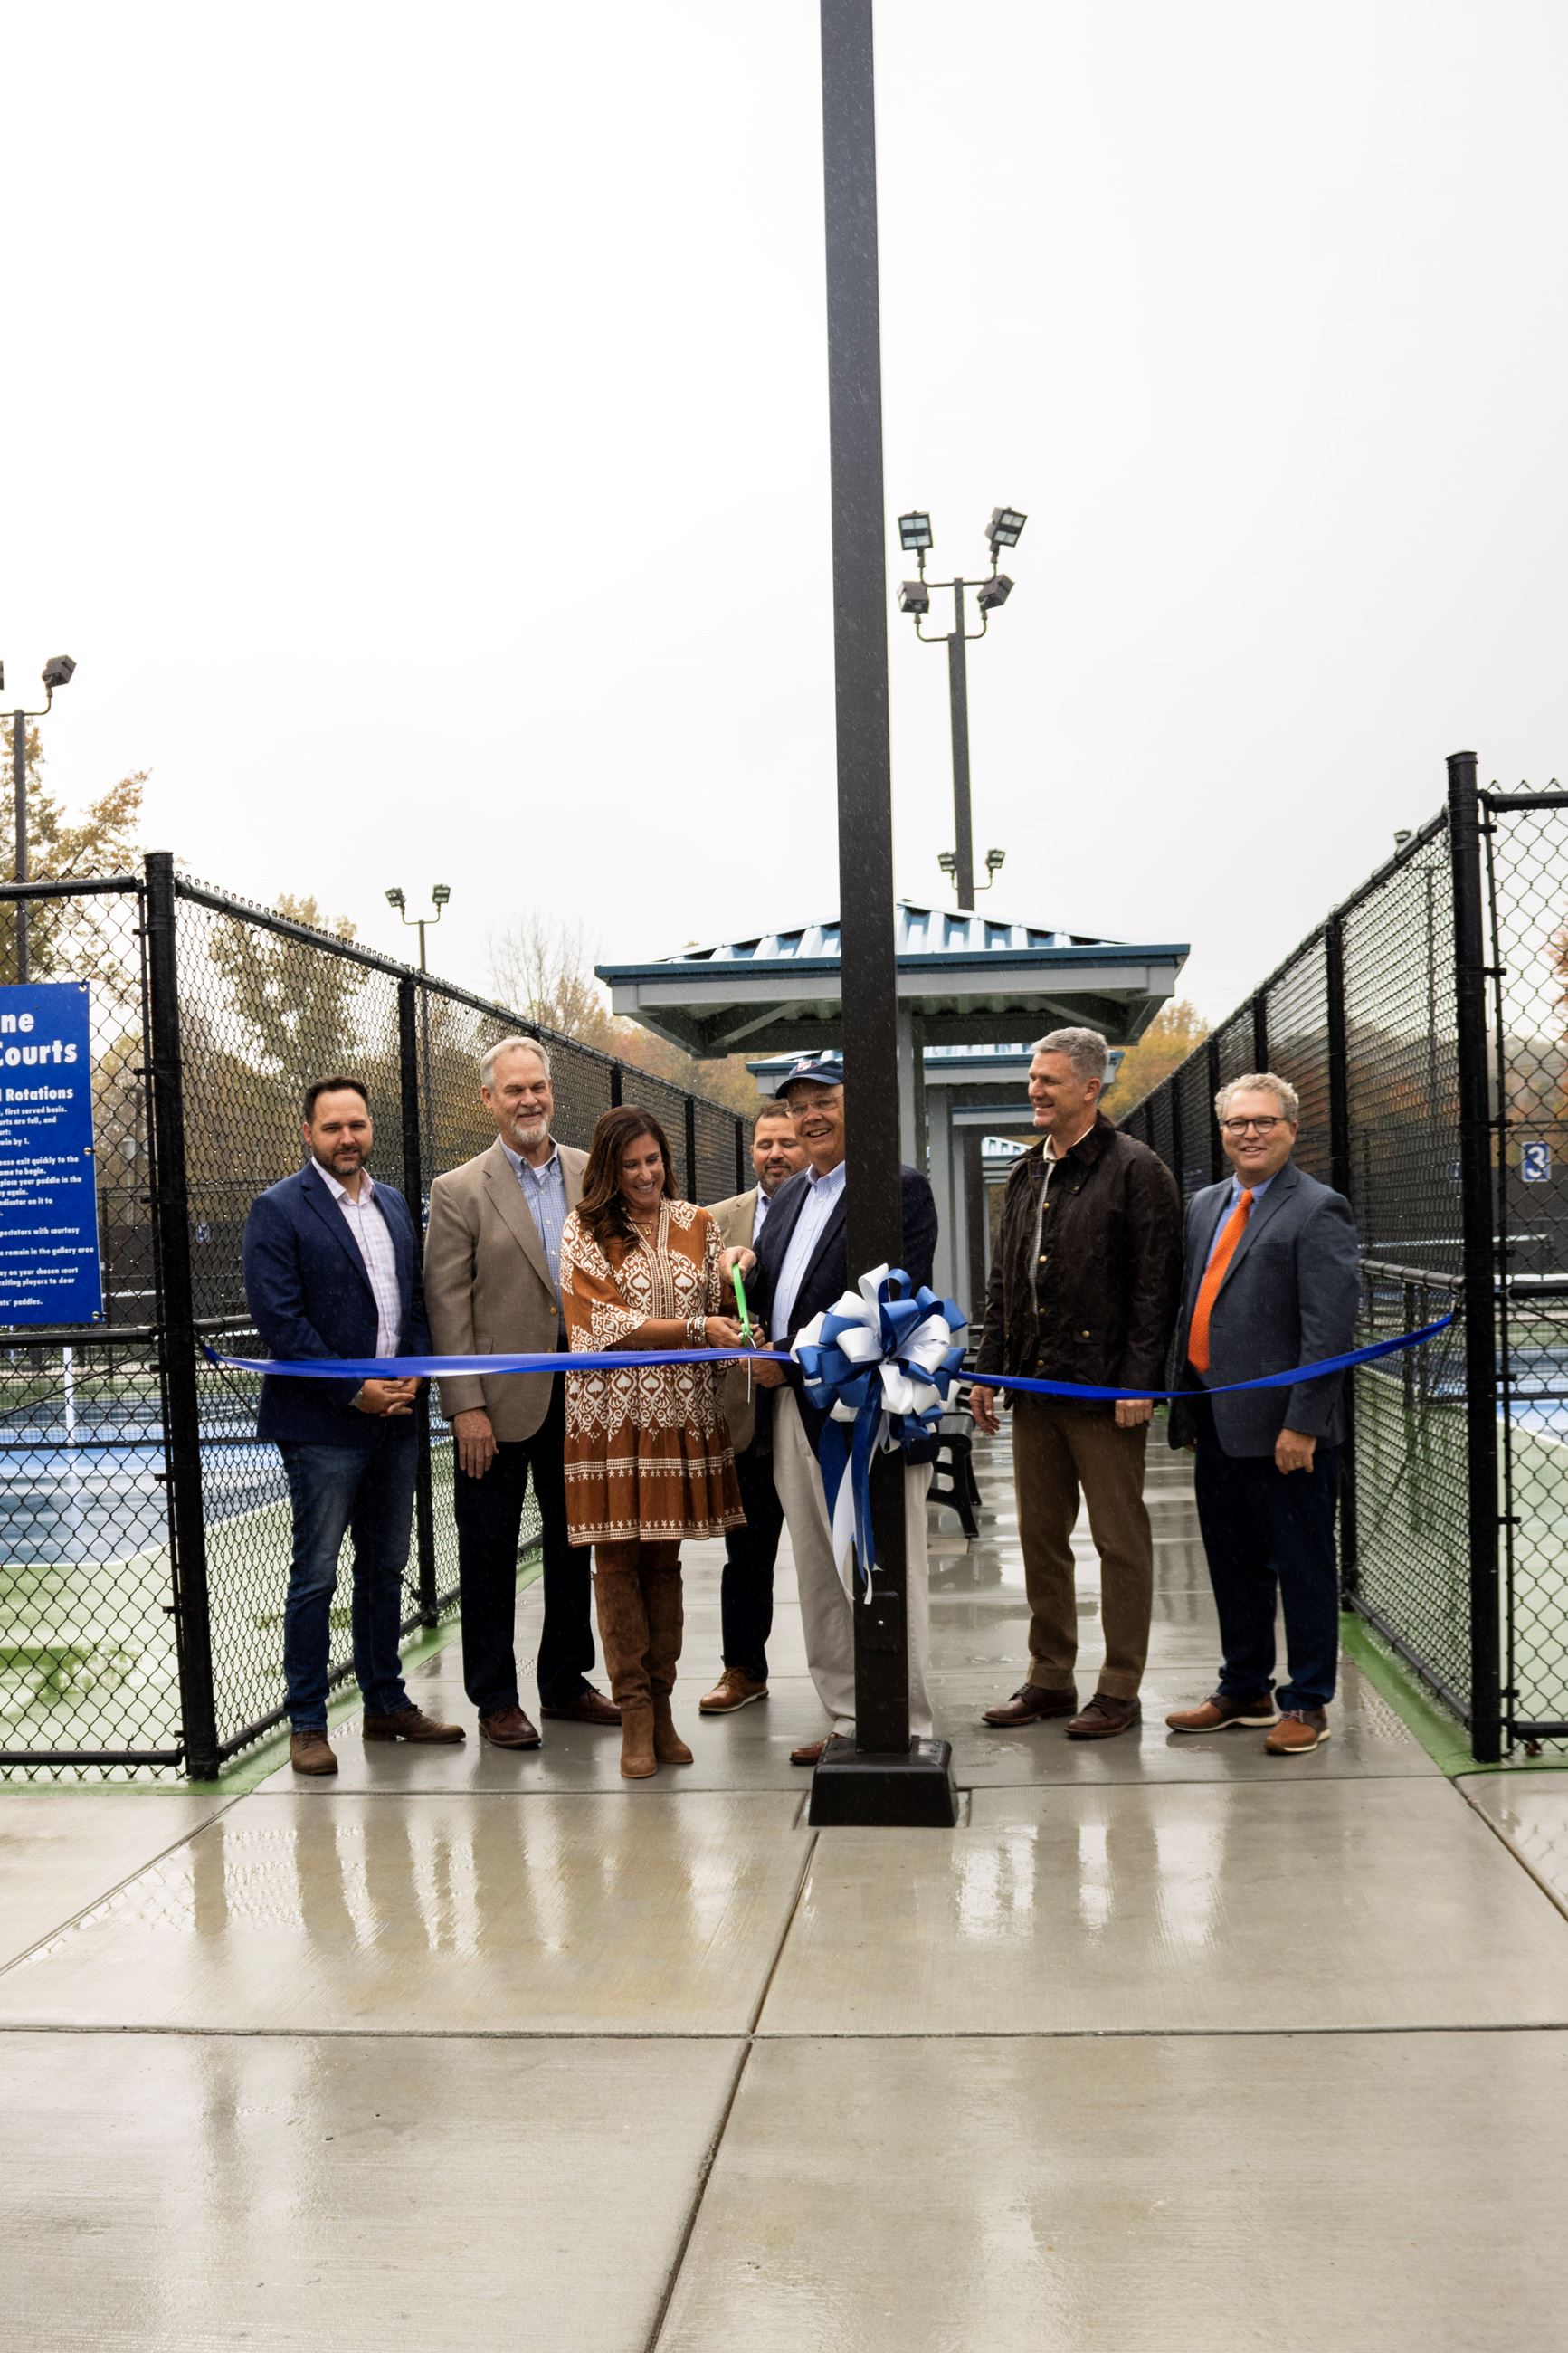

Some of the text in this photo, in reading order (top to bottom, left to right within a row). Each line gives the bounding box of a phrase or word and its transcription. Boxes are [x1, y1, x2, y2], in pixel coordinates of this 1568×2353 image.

[0, 1040, 77, 1066] ourts
[5, 1086, 73, 1101] Rotations
[5, 1105, 67, 1115] first served basis.
[27, 1116, 41, 1124] full,
[43, 1115, 57, 1124] and
[13, 1138, 22, 1146] by
[31, 1156, 56, 1166] quickly
[1526, 1146, 1545, 1178] 3
[24, 1167, 47, 1176] begin.
[0, 1179, 18, 1188] place
[19, 1179, 35, 1187] your
[36, 1176, 60, 1186] paddle
[7, 1188, 29, 1198] again.
[33, 1227, 49, 1235] with
[50, 1227, 79, 1235] courtesy
[52, 1247, 76, 1256] gallery
[22, 1278, 48, 1287] players
[13, 1298, 43, 1307] paddles.
